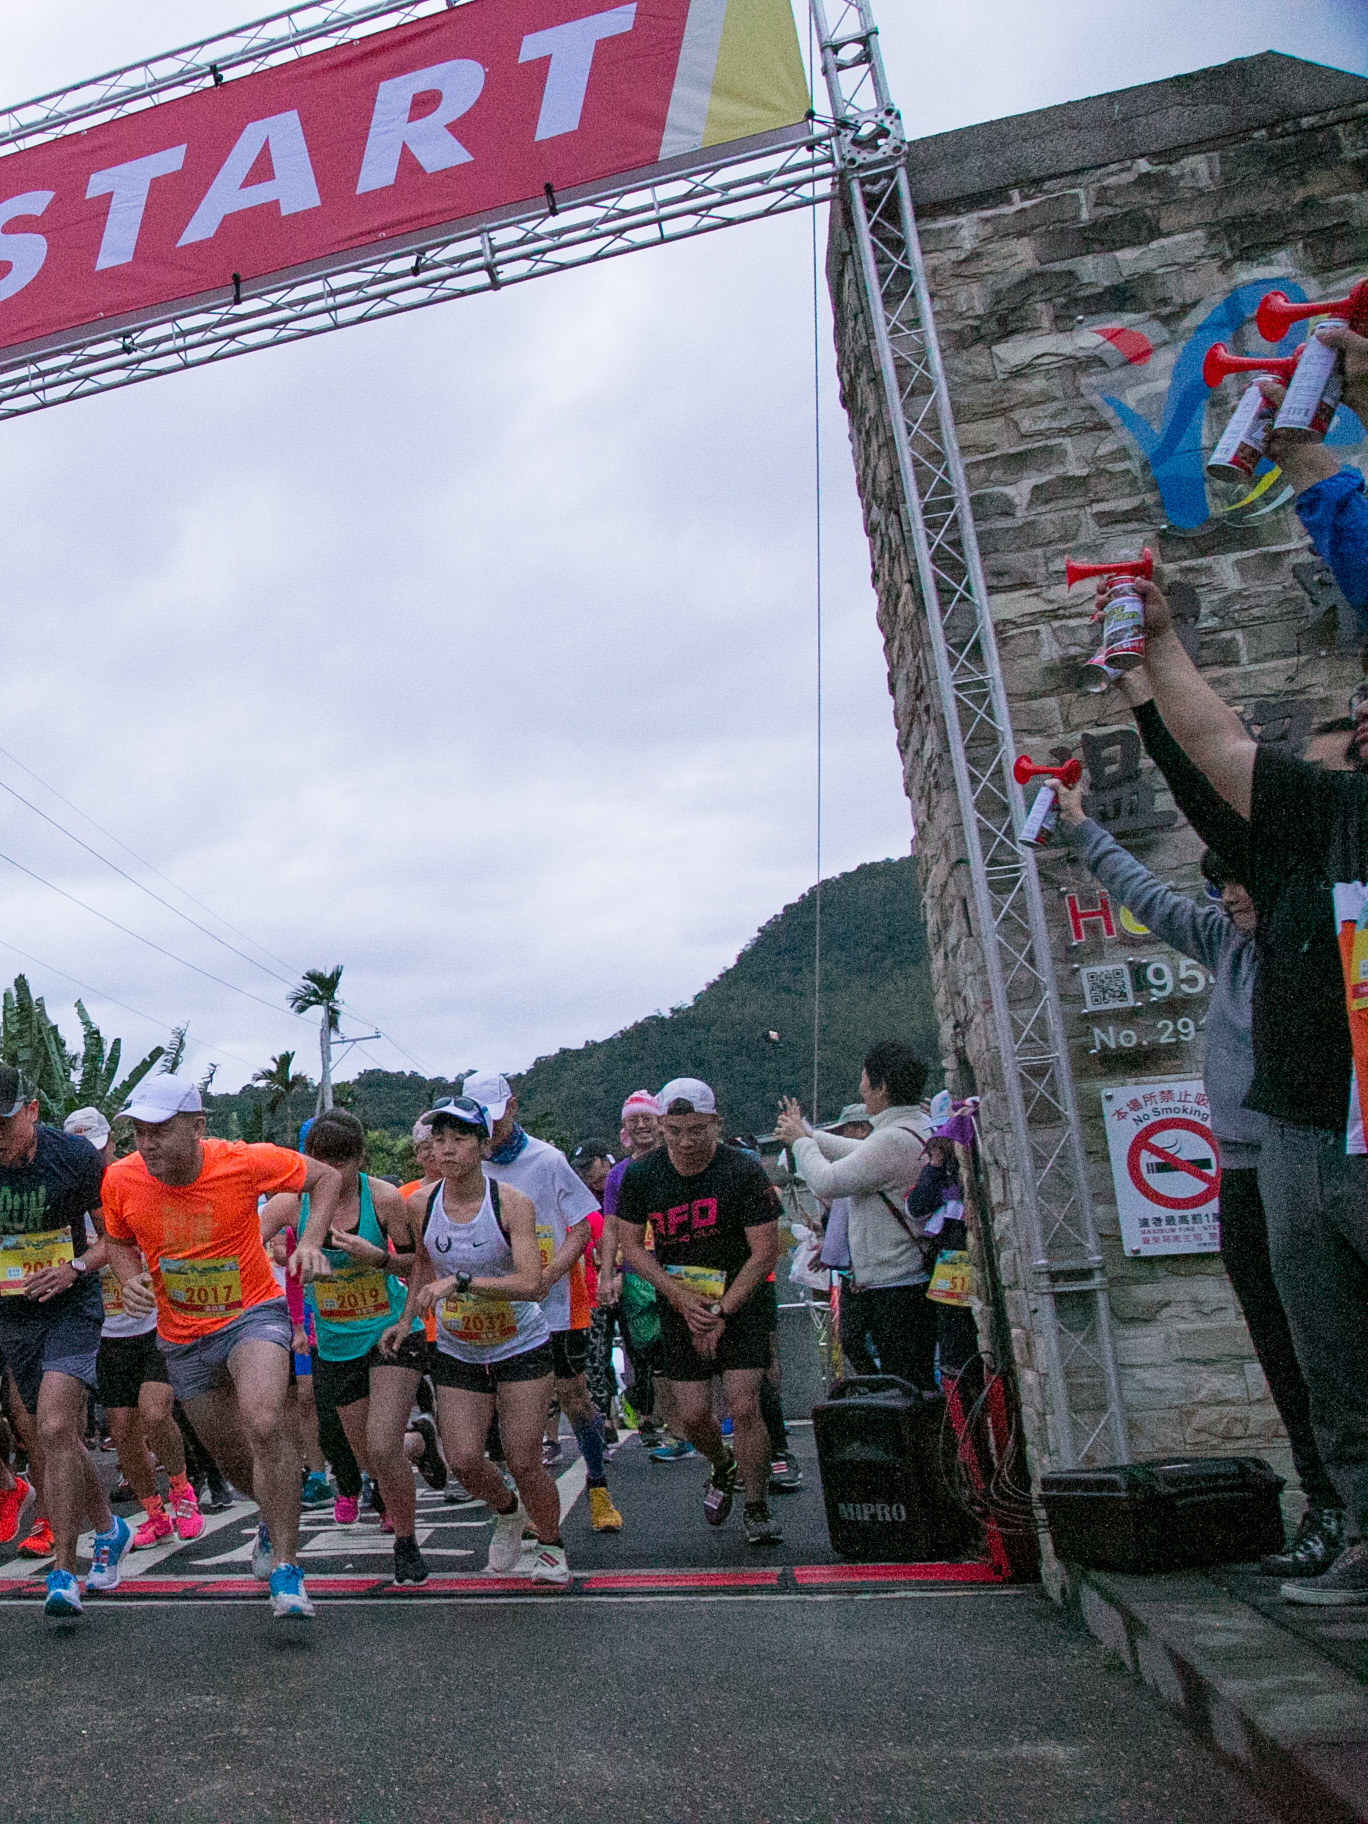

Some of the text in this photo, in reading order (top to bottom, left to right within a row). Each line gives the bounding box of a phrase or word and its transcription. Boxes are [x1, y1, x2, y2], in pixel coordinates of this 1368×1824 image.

[1146, 958, 1216, 997] 95
[1093, 1012, 1209, 1051] No. 29
[1132, 1104, 1210, 1127] No Smoking
[185, 1285, 232, 1304] 2017
[337, 1287, 379, 1309] 2019
[838, 1503, 907, 1522] MIPRO
